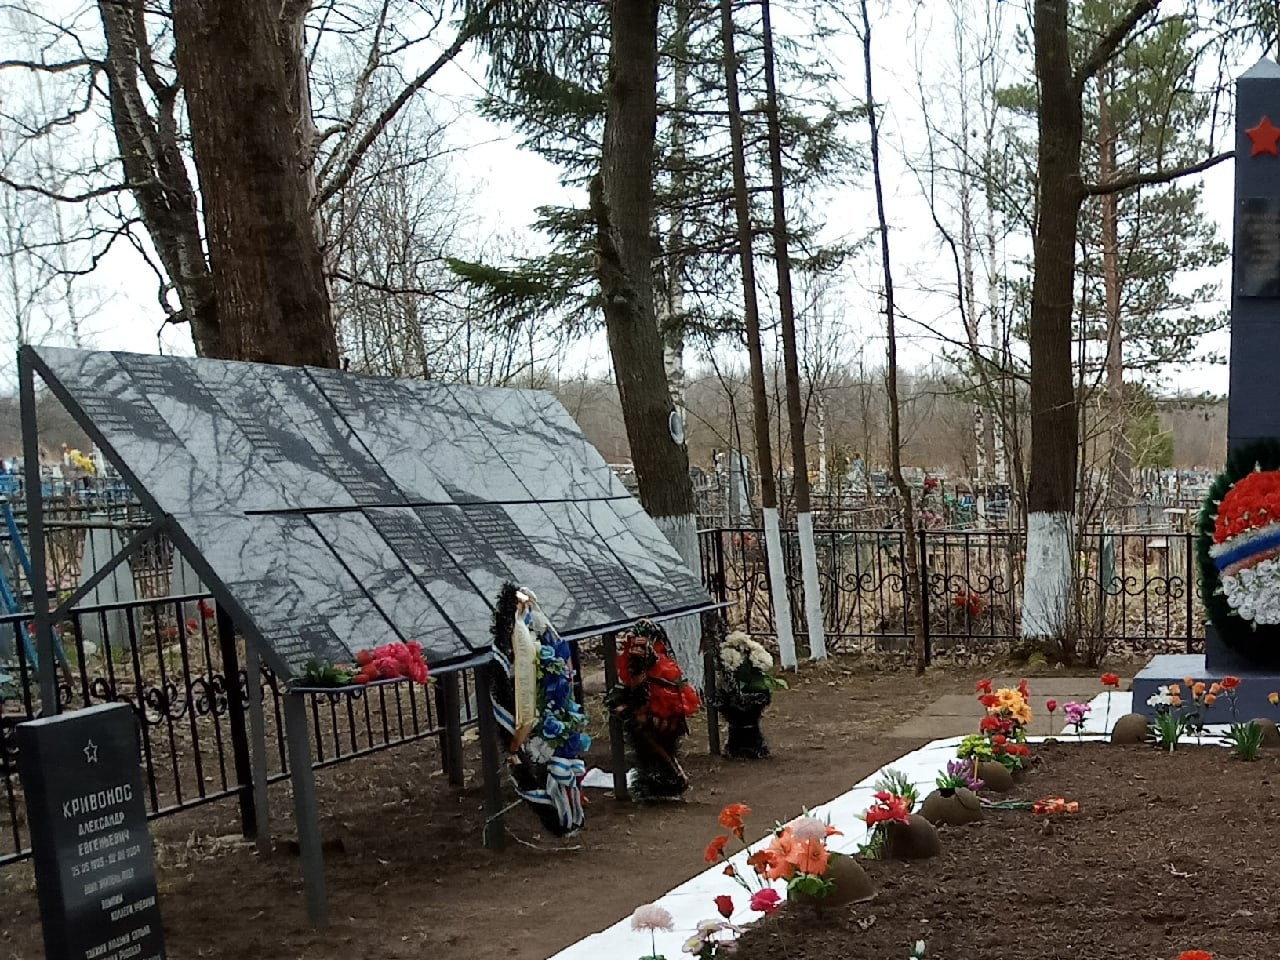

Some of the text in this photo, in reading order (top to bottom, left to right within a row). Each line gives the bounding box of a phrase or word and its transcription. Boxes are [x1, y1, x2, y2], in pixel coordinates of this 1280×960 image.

[62, 783, 133, 818] КРИВОНОС
[78, 811, 125, 836] АЛЕКСАНДР
[77, 829, 130, 857] ЕВГЕНЬЕВИЧ
